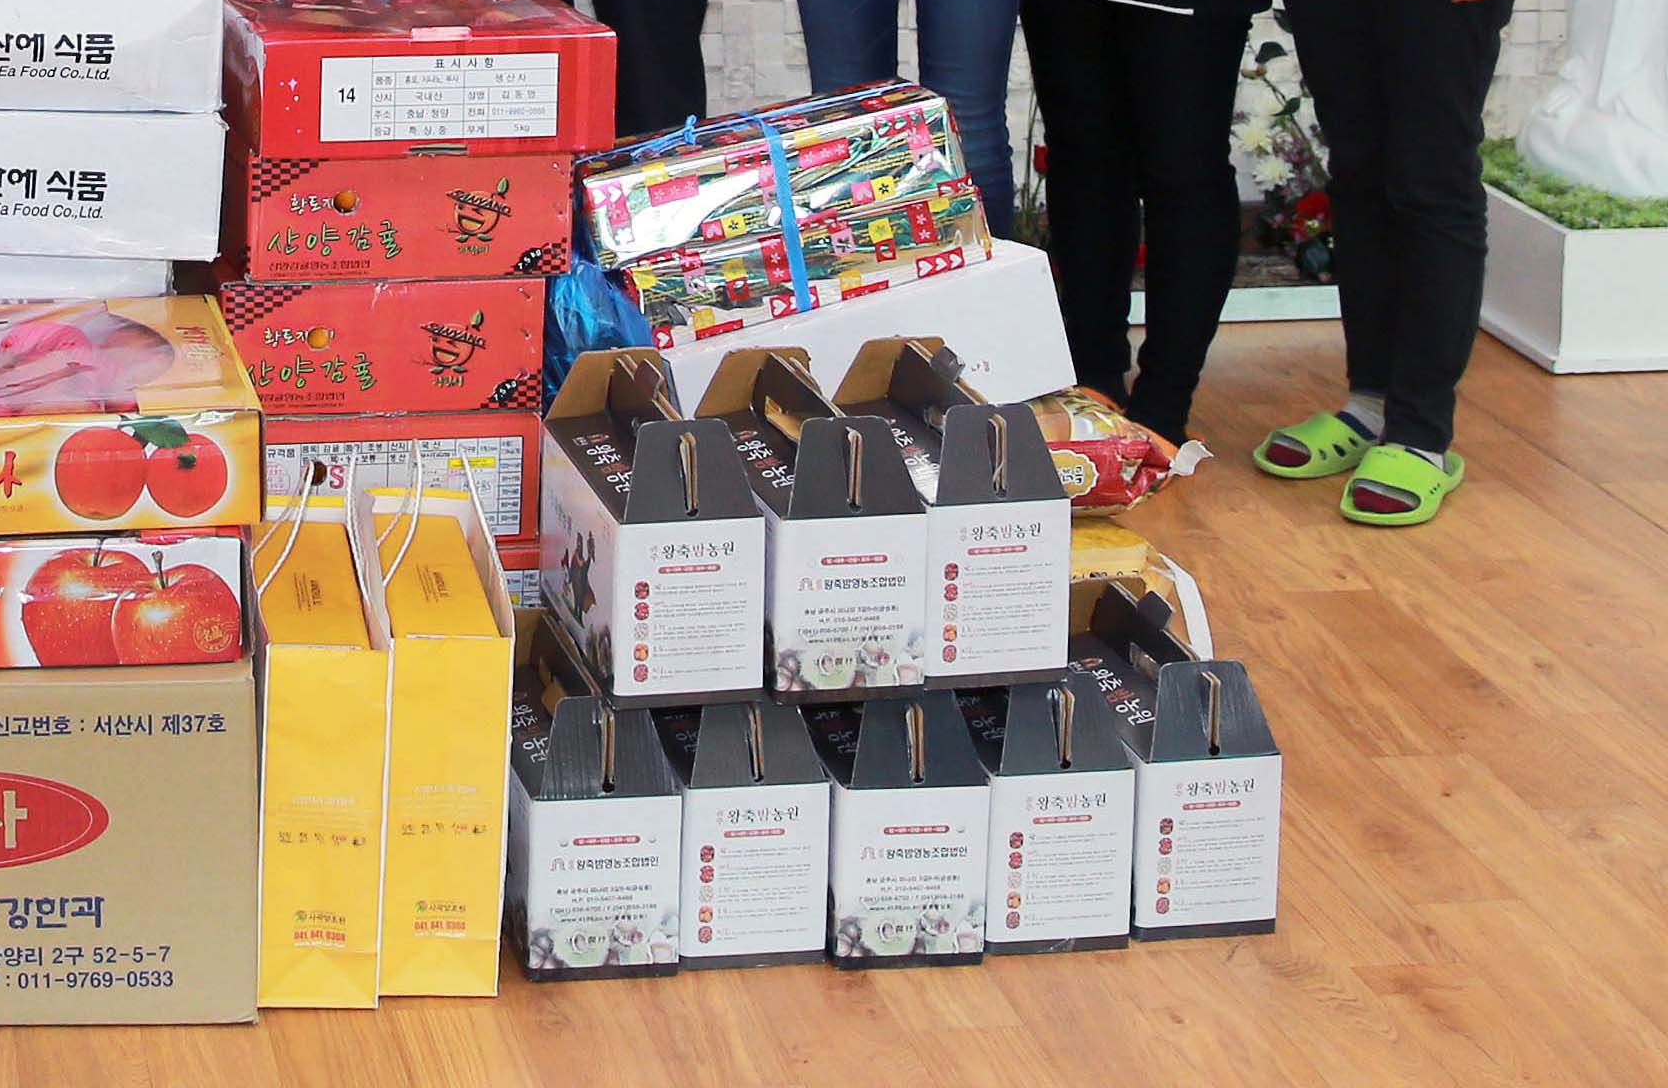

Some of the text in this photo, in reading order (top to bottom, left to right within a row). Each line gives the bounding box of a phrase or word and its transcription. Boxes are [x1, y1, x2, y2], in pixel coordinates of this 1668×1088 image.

[54, 33, 115, 64] 식품
[20, 66, 57, 79] Food
[59, 67, 111, 81] Co.,Ltd.
[337, 87, 356, 104] 14
[415, 90, 443, 102] 국내산
[374, 109, 392, 120] 주소
[46, 170, 108, 202] 식품
[13, 203, 49, 218] Food
[52, 204, 104, 220] Co.,Ltd.
[328, 464, 345, 490] S
[93, 714, 153, 737] 서산시
[161, 713, 227, 736] 제37호
[52, 946, 84, 966] 2구
[92, 945, 171, 964] 52-5-7
[17, 970, 174, 990] 011-9769-0533
